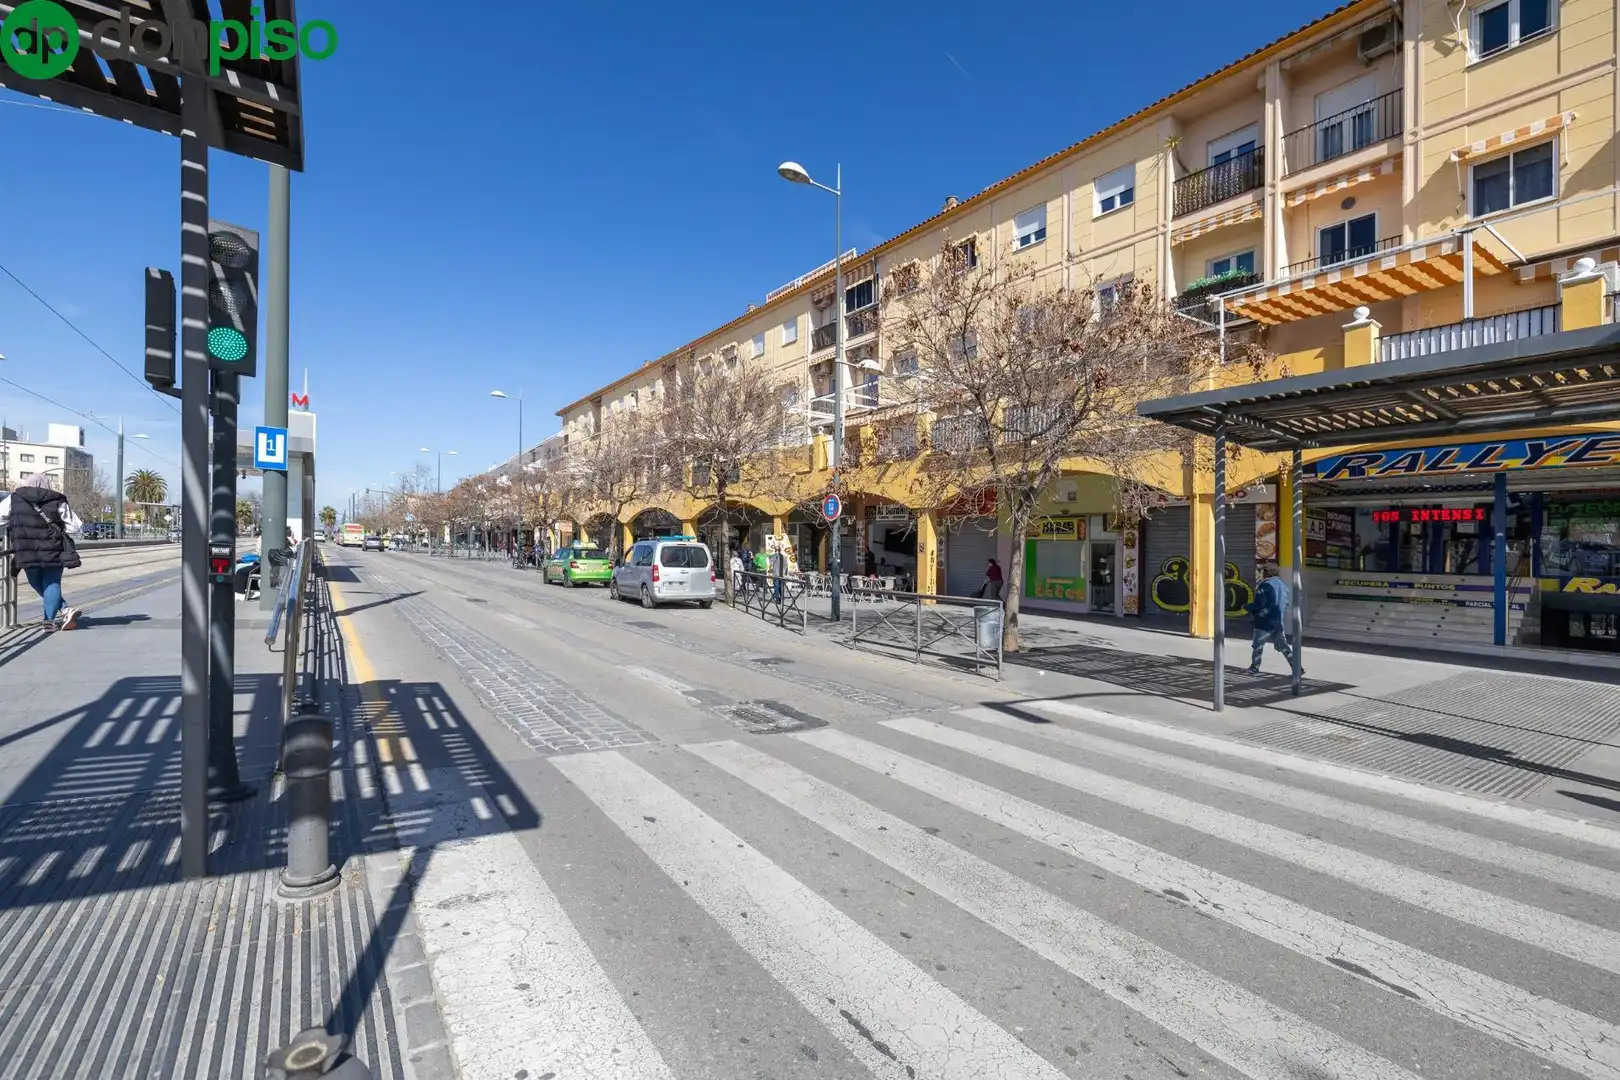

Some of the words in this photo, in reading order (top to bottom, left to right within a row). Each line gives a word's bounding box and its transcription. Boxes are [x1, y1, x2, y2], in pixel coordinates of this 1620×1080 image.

[291, 393, 310, 406] M
[266, 439, 276, 452] 1
[1411, 508, 1484, 520] INTENSI
[1414, 583, 1456, 591] PUNTOS
